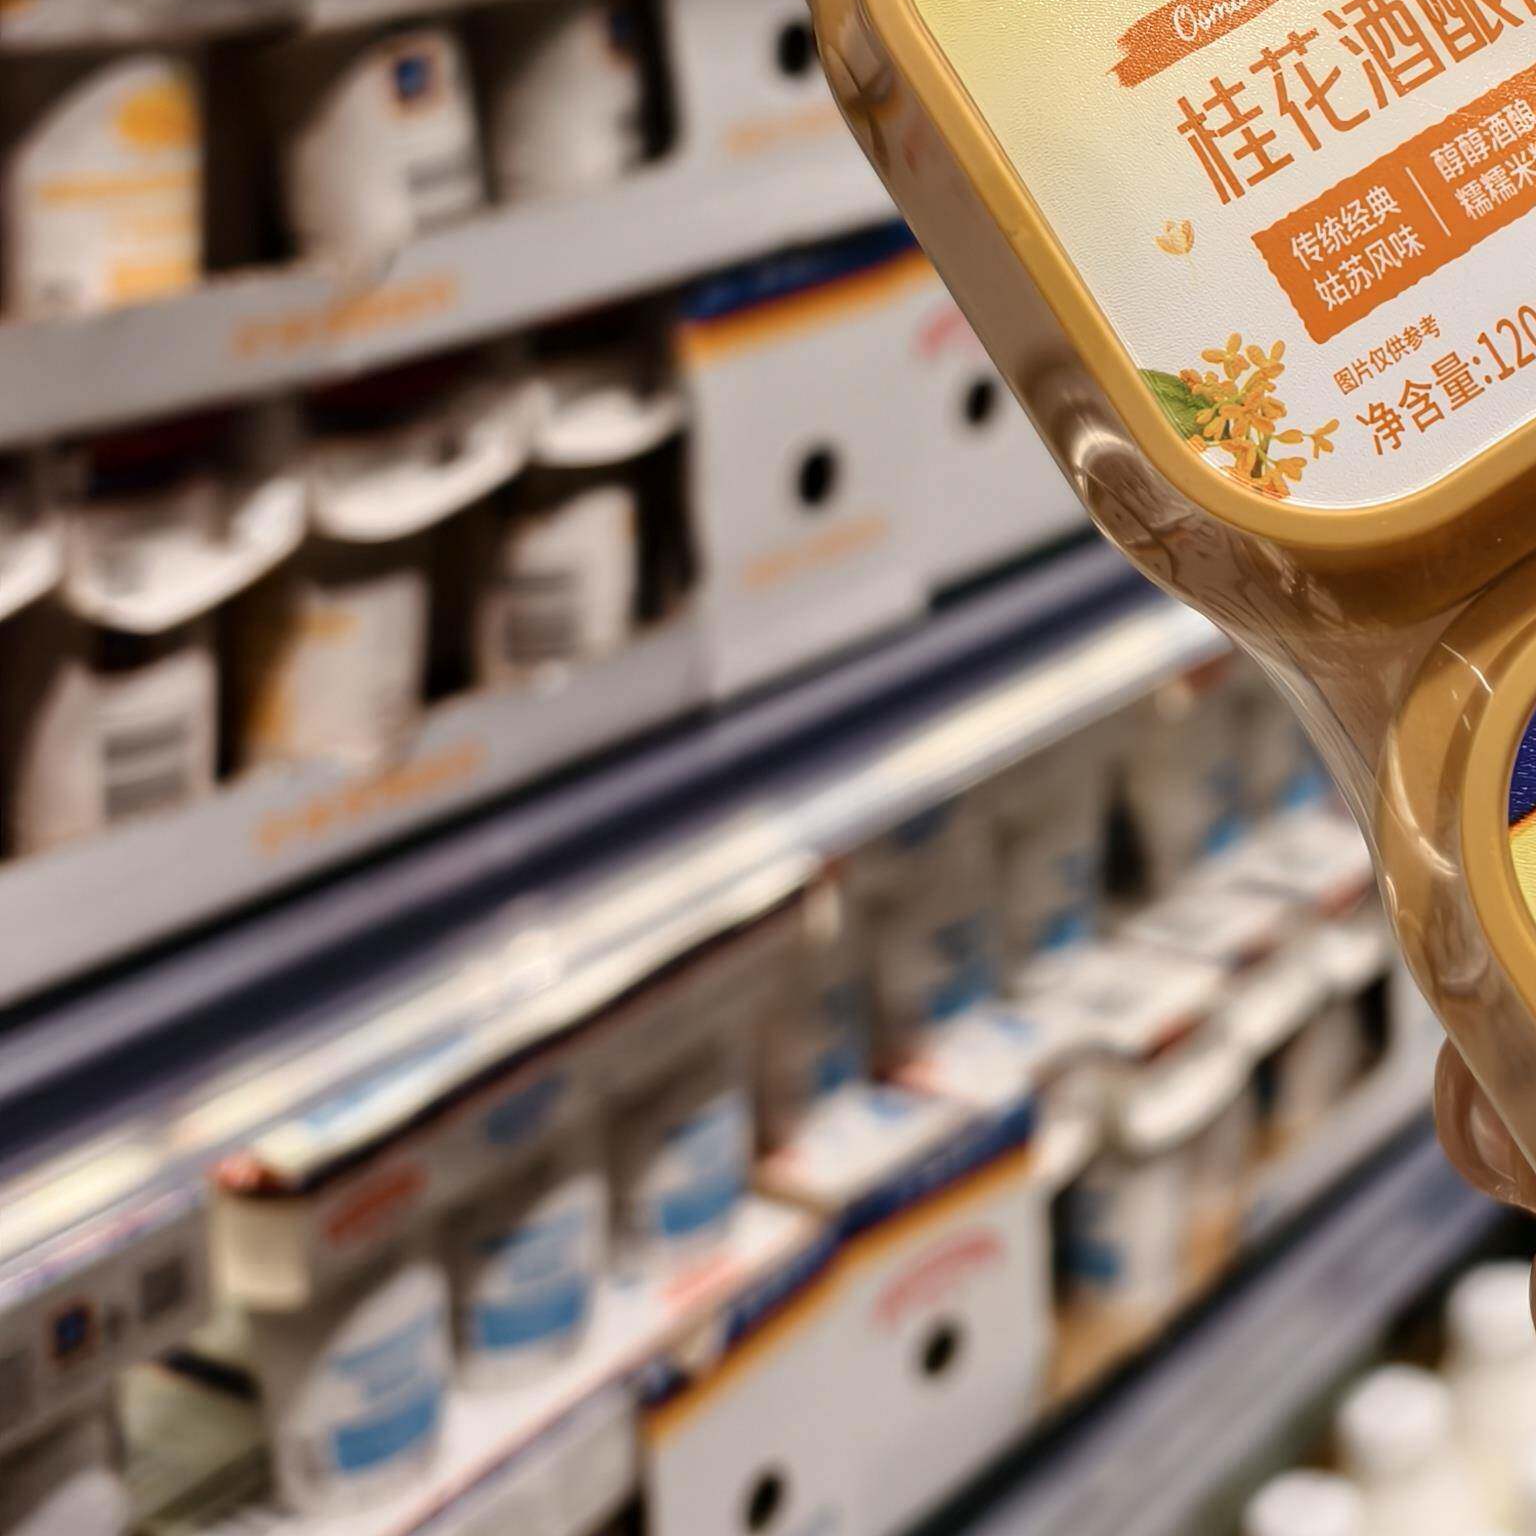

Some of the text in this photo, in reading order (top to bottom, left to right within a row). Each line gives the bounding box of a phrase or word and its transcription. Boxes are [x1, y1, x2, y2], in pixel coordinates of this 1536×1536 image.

[1290, 184, 1401, 271] 传统经典
[1312, 224, 1425, 311] 姑苏风味
[1333, 314, 1442, 395] 图片仅供参考
